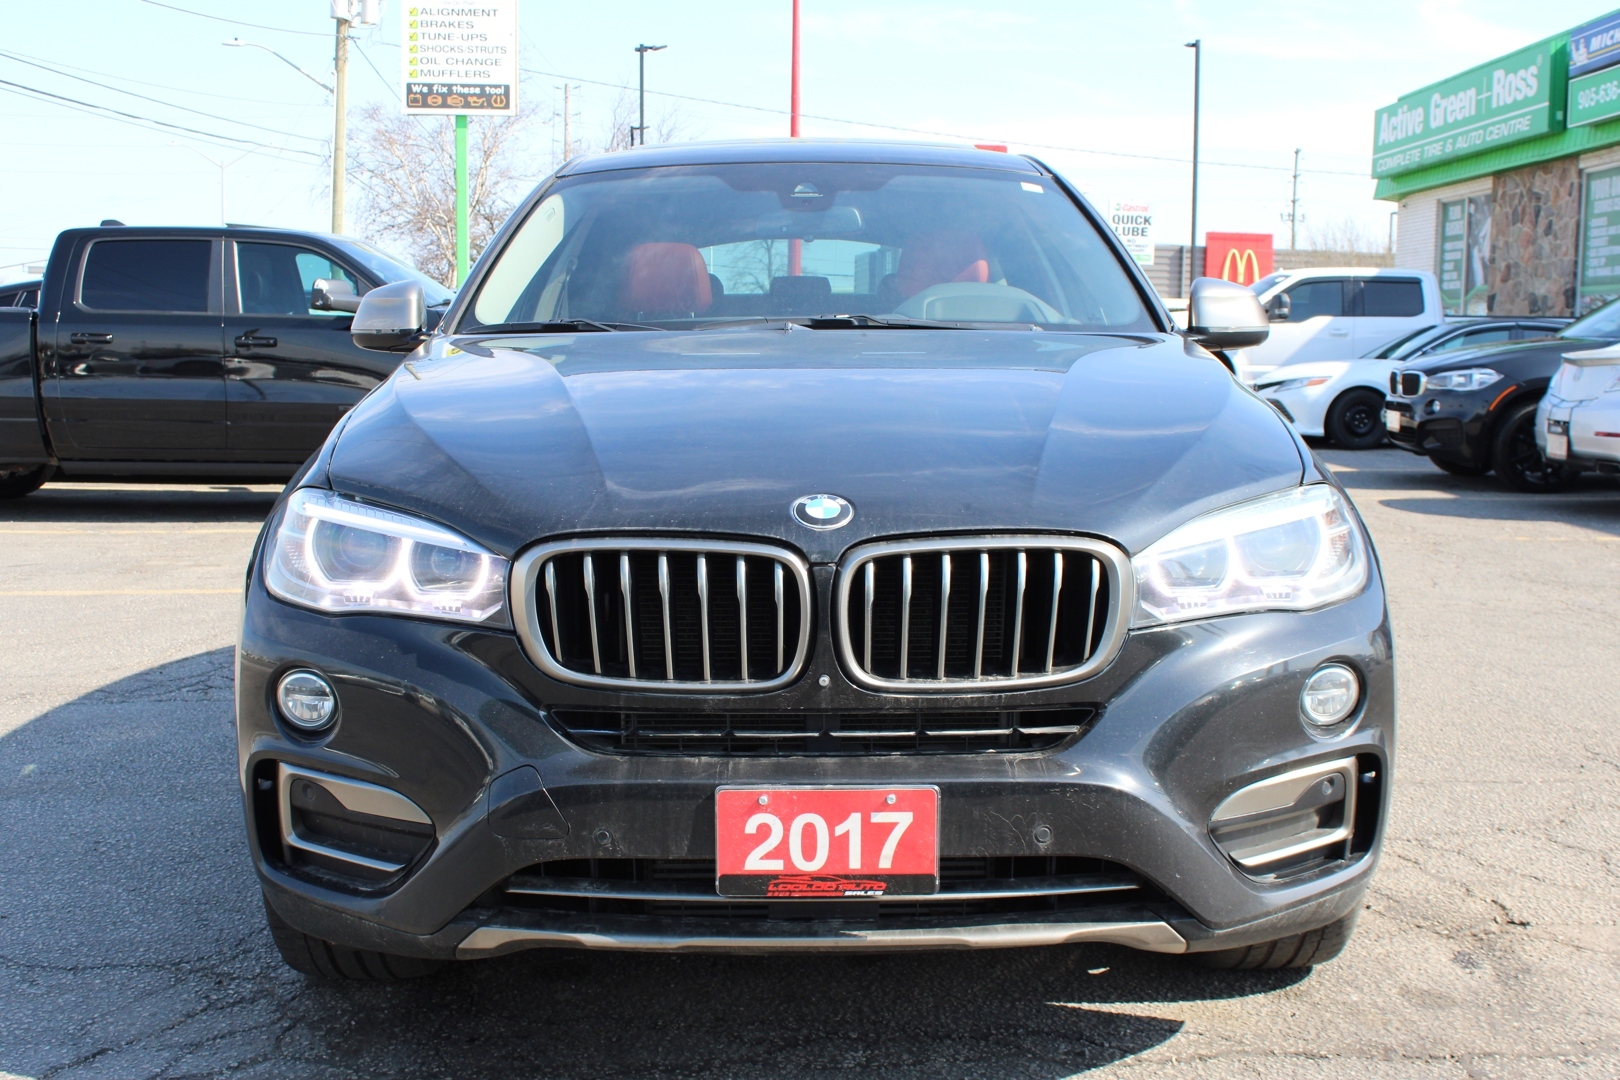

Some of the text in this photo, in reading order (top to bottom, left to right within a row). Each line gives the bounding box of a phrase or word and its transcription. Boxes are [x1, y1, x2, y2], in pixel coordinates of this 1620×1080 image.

[420, 8, 499, 17] ALIGNMENT
[420, 20, 474, 29] BRAKES
[420, 32, 488, 41] TUNE-UPS
[420, 44, 507, 54] SHOCKS/STRUTS
[420, 57, 502, 66] OIL CHANGE
[420, 69, 491, 78] MUFFLERS
[411, 84, 428, 93] We
[433, 84, 448, 93] fix
[452, 85, 481, 94] these
[1378, 105, 1424, 147] Active
[1430, 87, 1477, 129] Green
[1492, 65, 1539, 109] Ross
[1376, 115, 1532, 172] COMPLETE TIRE & AUTO CENTRE
[1112, 214, 1152, 226] QUICK
[744, 811, 914, 872] 2017
